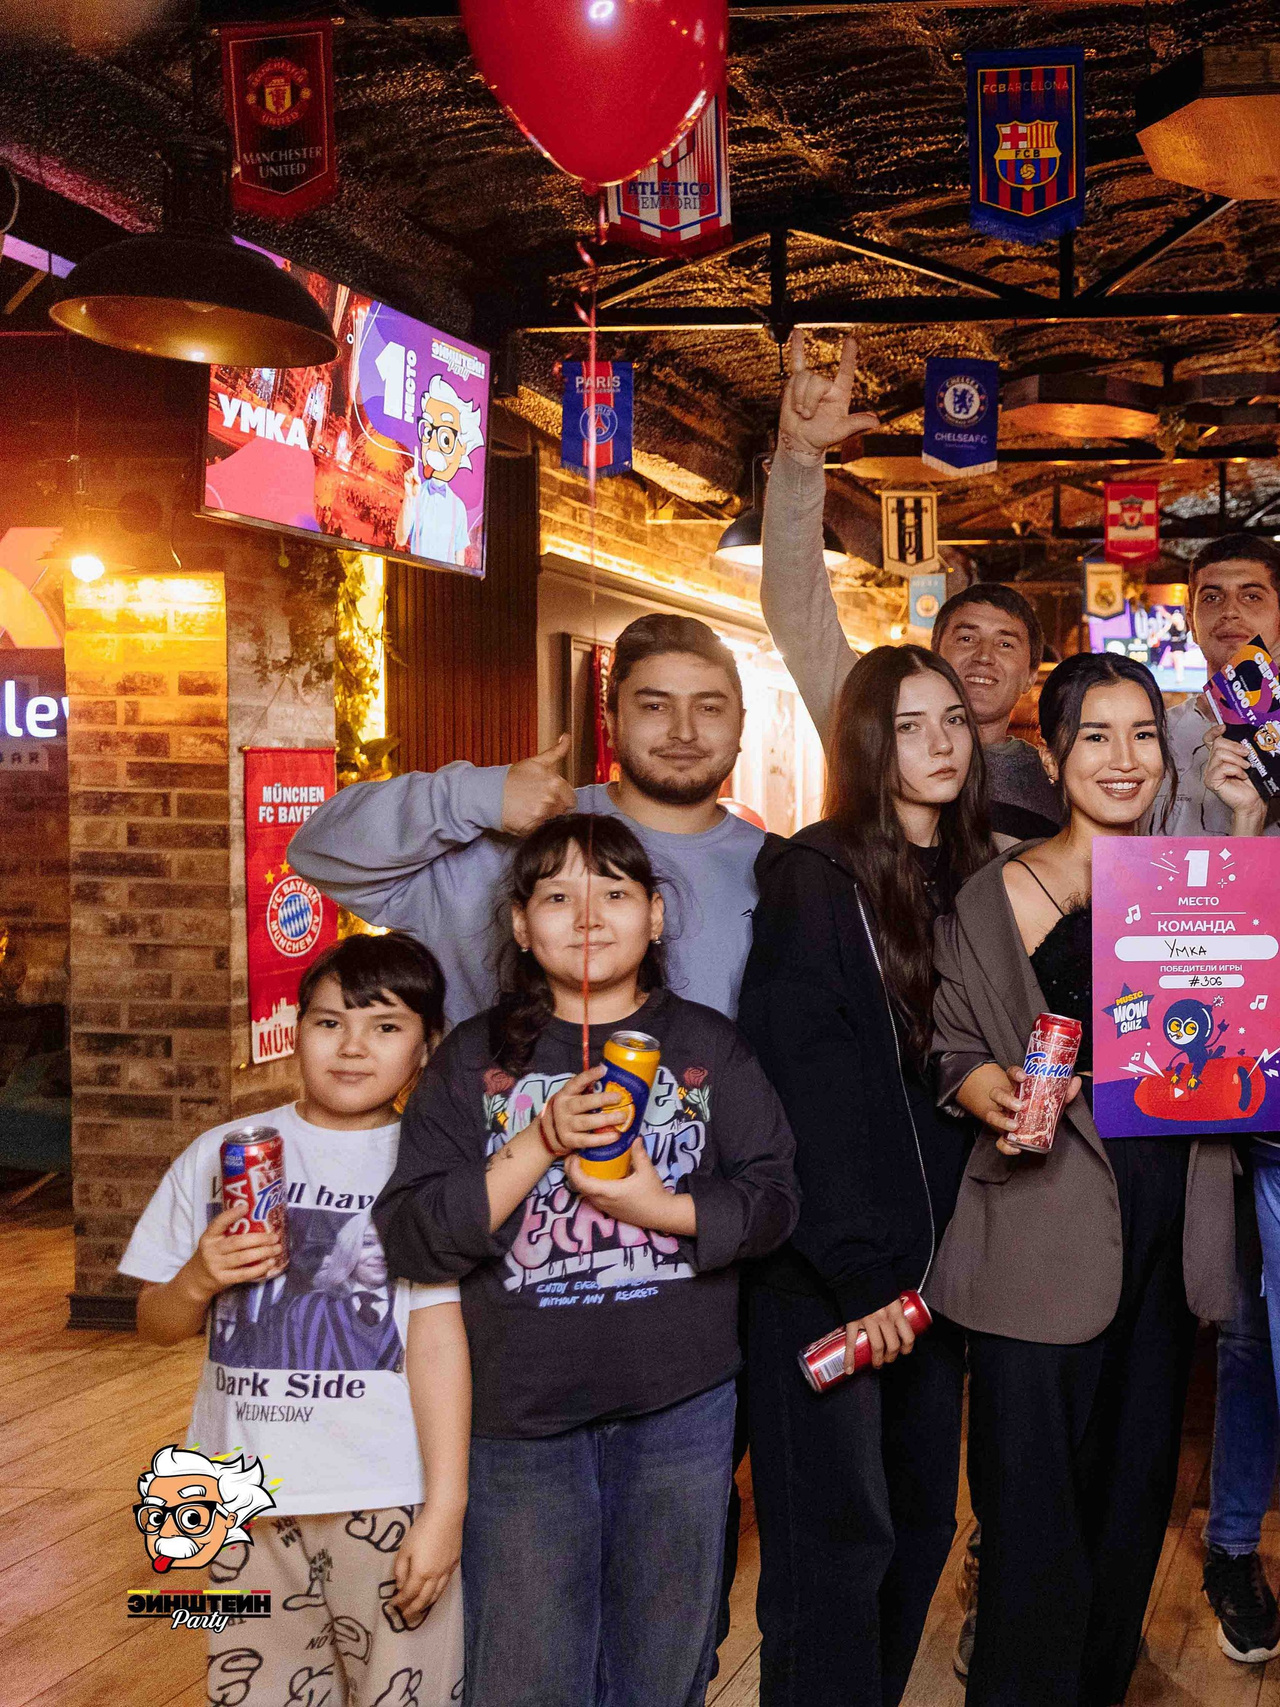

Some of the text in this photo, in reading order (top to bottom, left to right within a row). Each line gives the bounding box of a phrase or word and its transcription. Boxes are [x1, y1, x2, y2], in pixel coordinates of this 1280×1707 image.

[241, 145, 323, 165] MANCHESTER
[1014, 148, 1041, 158] FCB
[258, 162, 306, 179] UNITED
[627, 178, 711, 197] ATLÉTICO
[374, 341, 406, 421] 1
[403, 350, 418, 424] МЕСТО
[575, 375, 622, 389] PARIS
[217, 392, 310, 451] УМКА
[262, 782, 325, 803] MÜNCHEN
[258, 805, 275, 823] FC
[1184, 850, 1210, 887] 1
[271, 879, 320, 910] FC BAYERN
[1177, 896, 1219, 906] МЕСТО
[1157, 920, 1236, 933] КОМАНДА
[1160, 964, 1243, 974] ПОБЕДИТЕЛИ ИГРЫ
[1188, 974, 1223, 988] #306
[1115, 990, 1144, 1006] MUSIC
[1113, 999, 1148, 1024] WOW
[1120, 1018, 1142, 1034] QUIZ
[216, 1366, 366, 1398] Dark Side
[235, 1400, 315, 1424] WEDNESDAY
